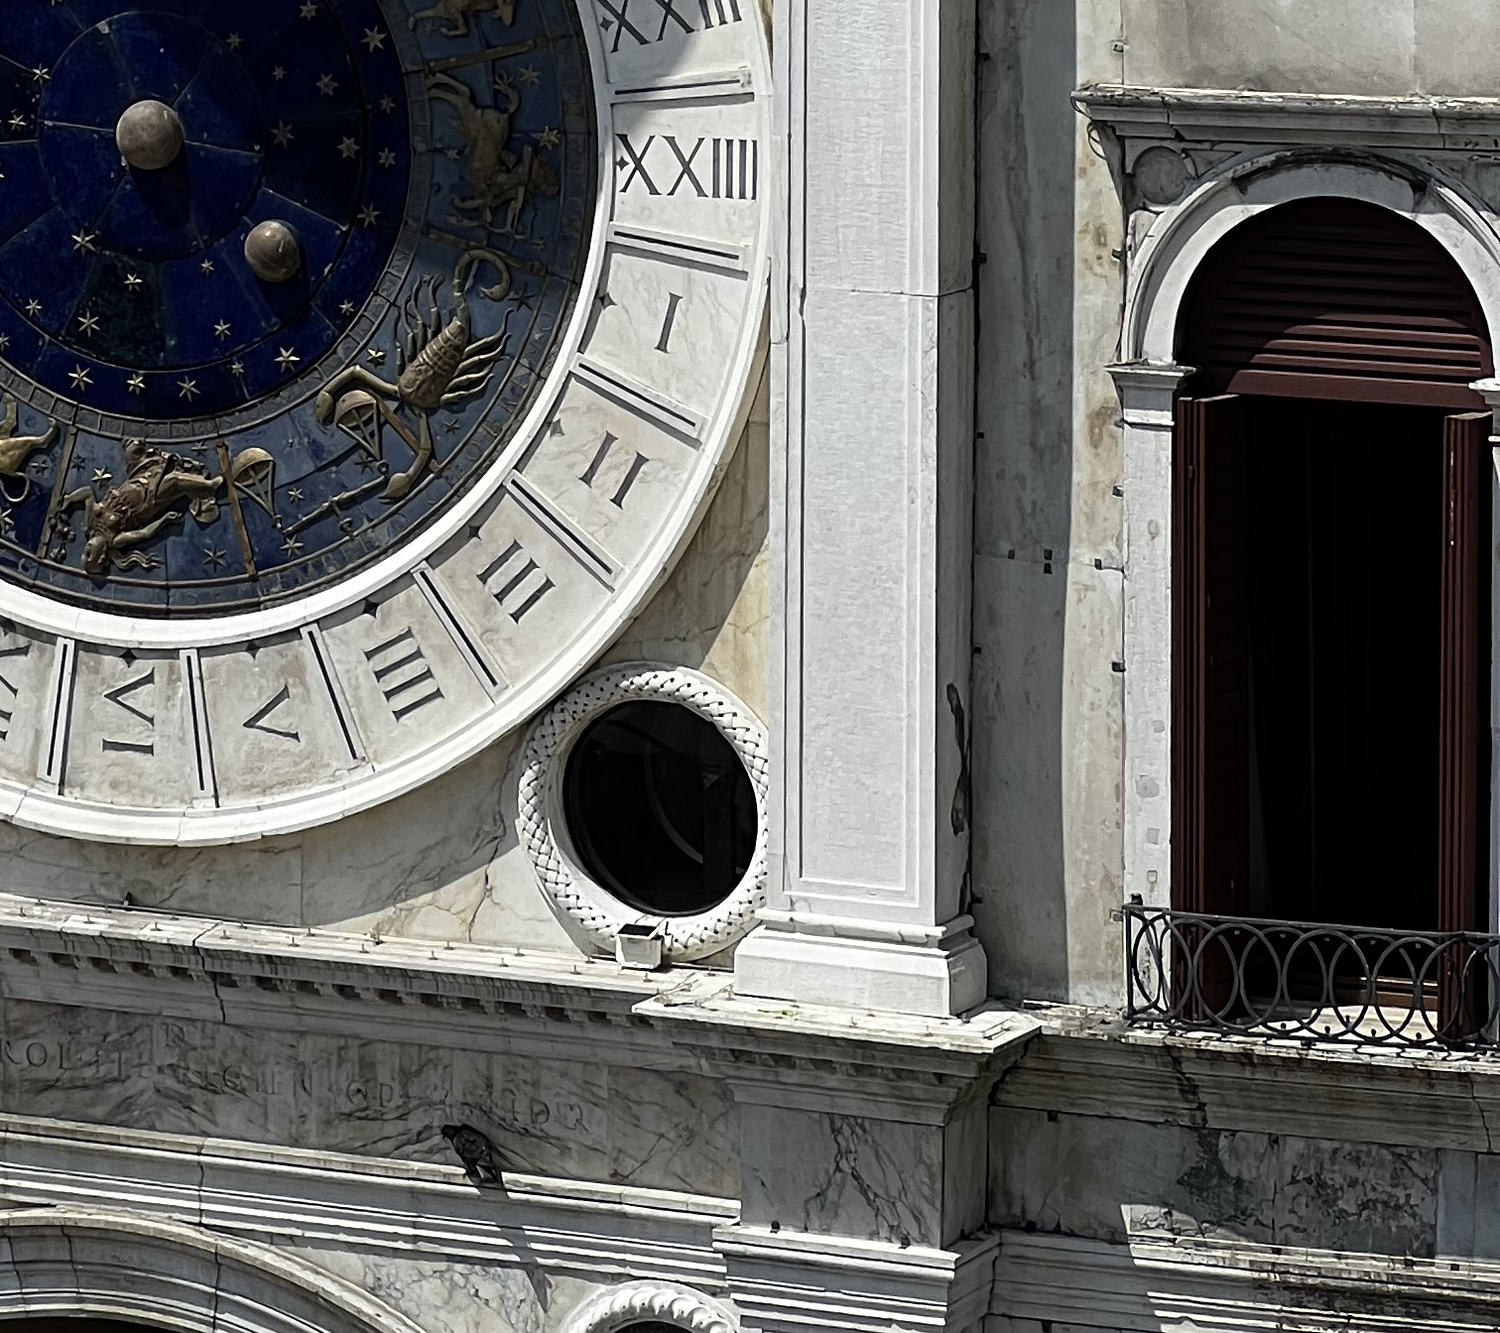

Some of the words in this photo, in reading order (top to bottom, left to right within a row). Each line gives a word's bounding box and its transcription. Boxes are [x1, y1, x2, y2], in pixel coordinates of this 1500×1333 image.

[615, 133, 758, 201] XXIIII
[654, 292, 684, 355] I
[577, 430, 651, 511] II
[477, 538, 557, 625] III
[361, 626, 446, 723] IIII
[242, 683, 302, 744] V
